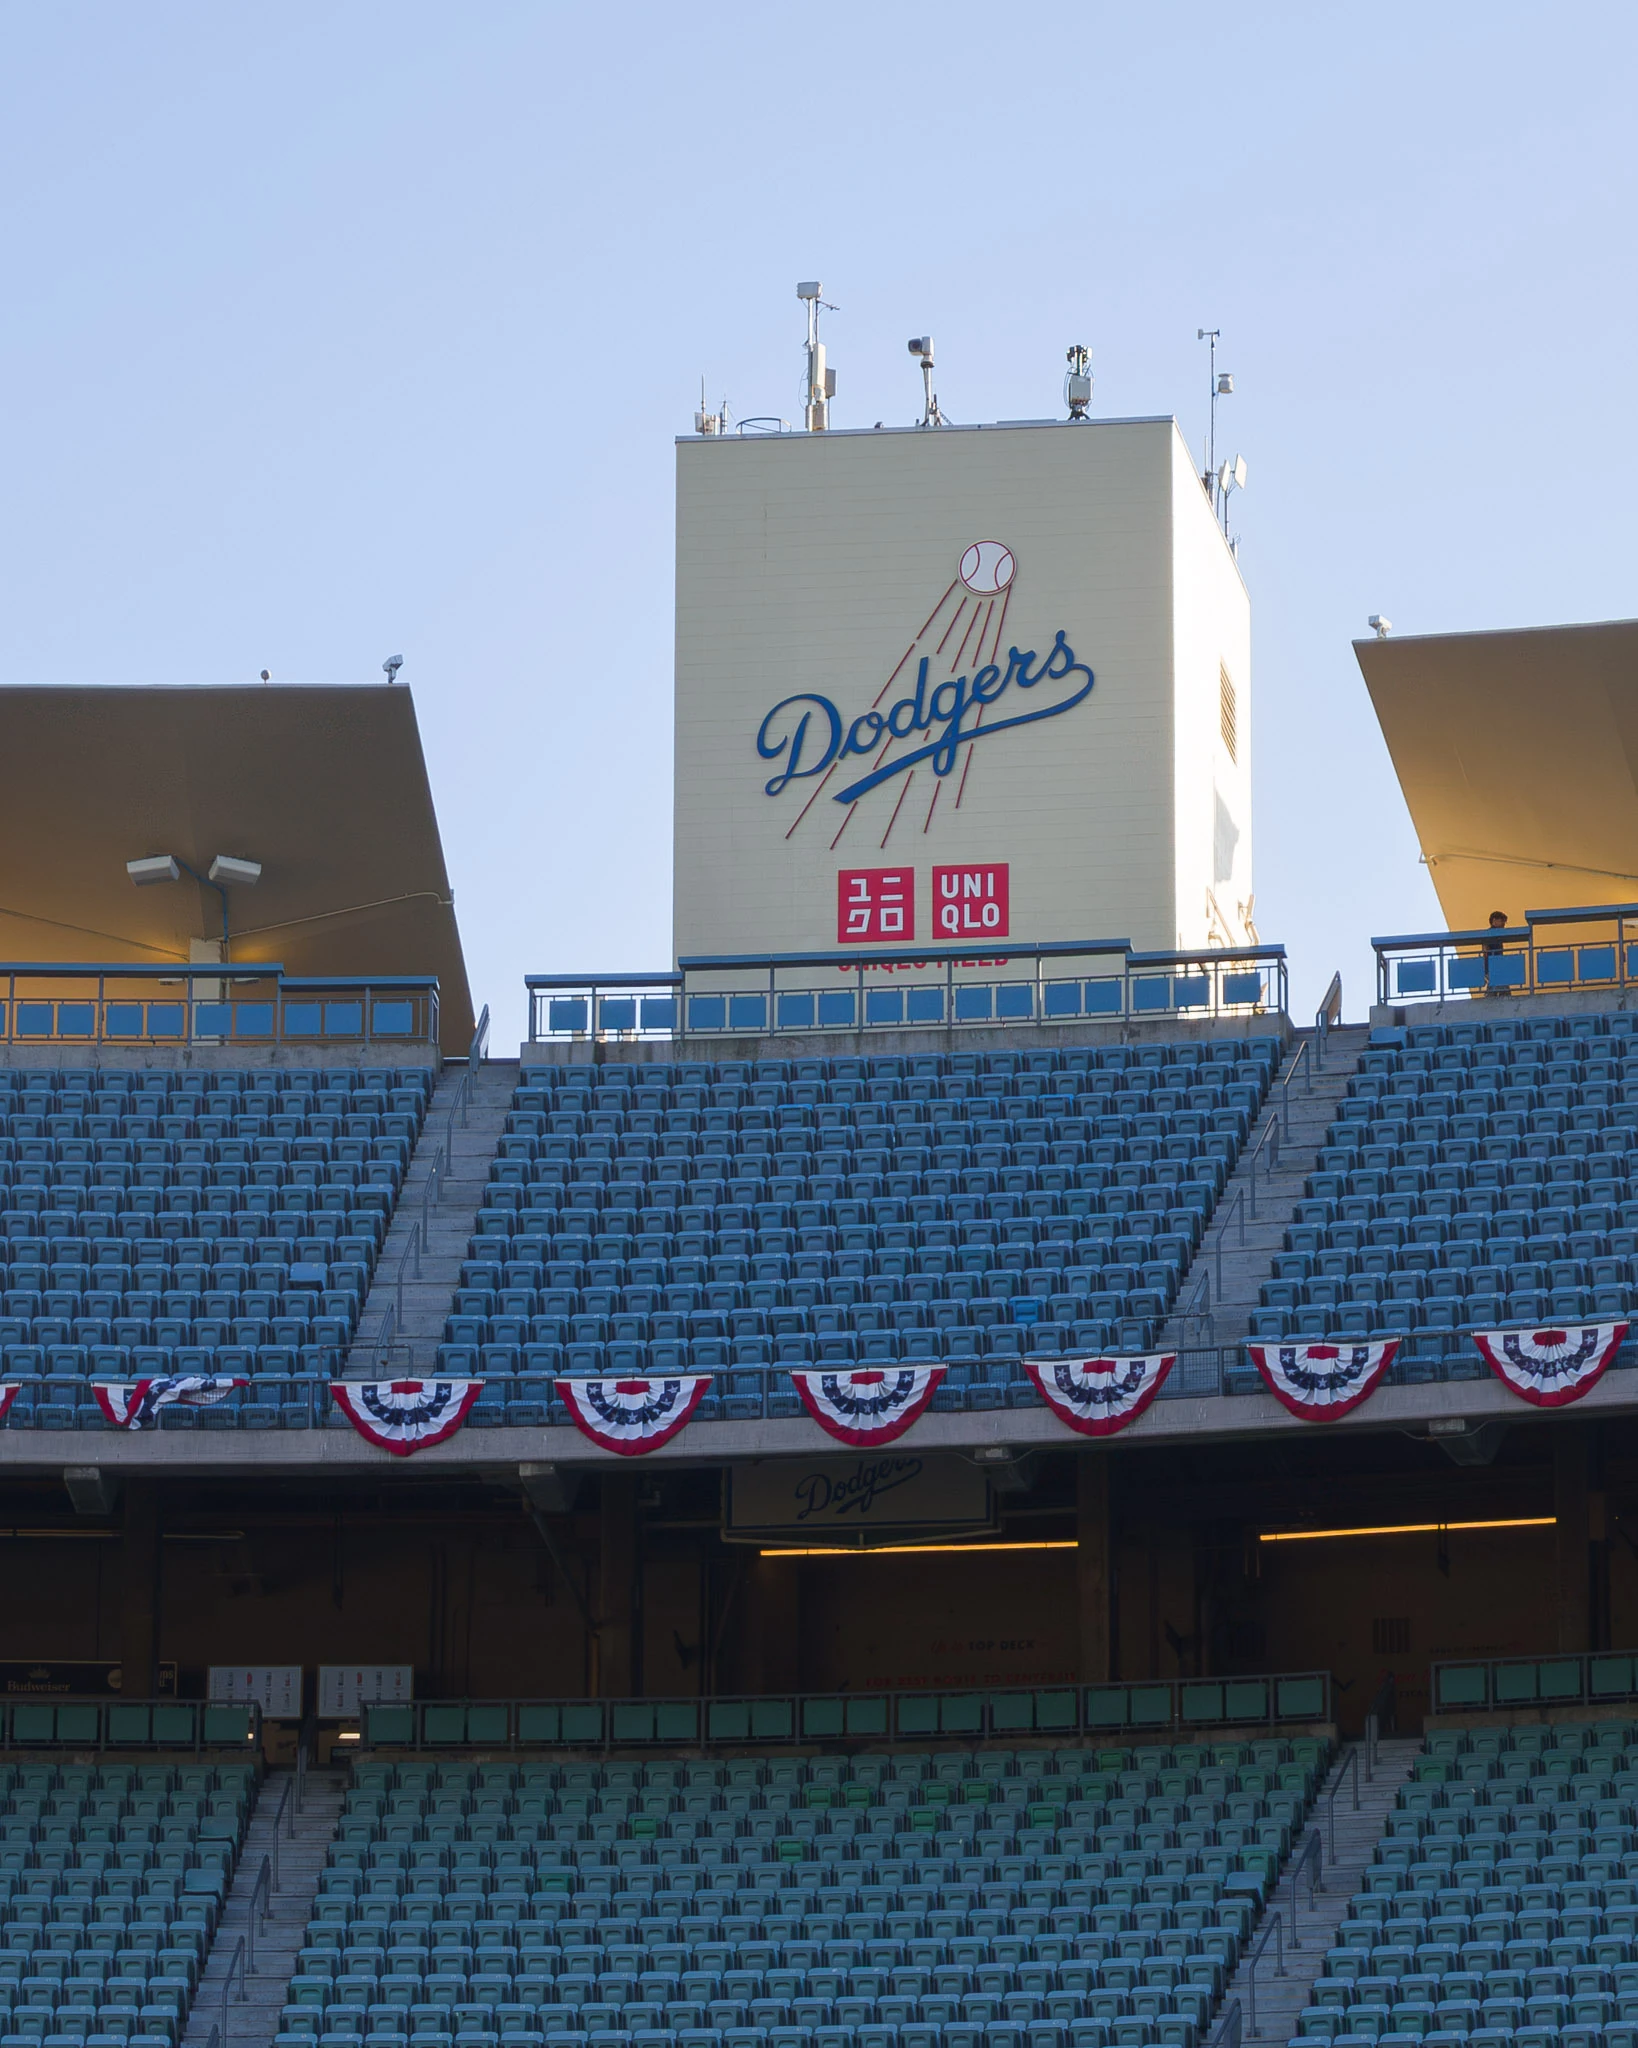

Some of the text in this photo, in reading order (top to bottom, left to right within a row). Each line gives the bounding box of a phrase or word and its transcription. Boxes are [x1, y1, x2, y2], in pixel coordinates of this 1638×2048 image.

[757, 630, 1094, 804] Dodgers
[848, 876, 904, 902] ユニ
[941, 872, 994, 898] UNI
[846, 907, 904, 933] クロ
[941, 903, 1000, 934] QLO
[7, 1680, 71, 1692] Budweiser
